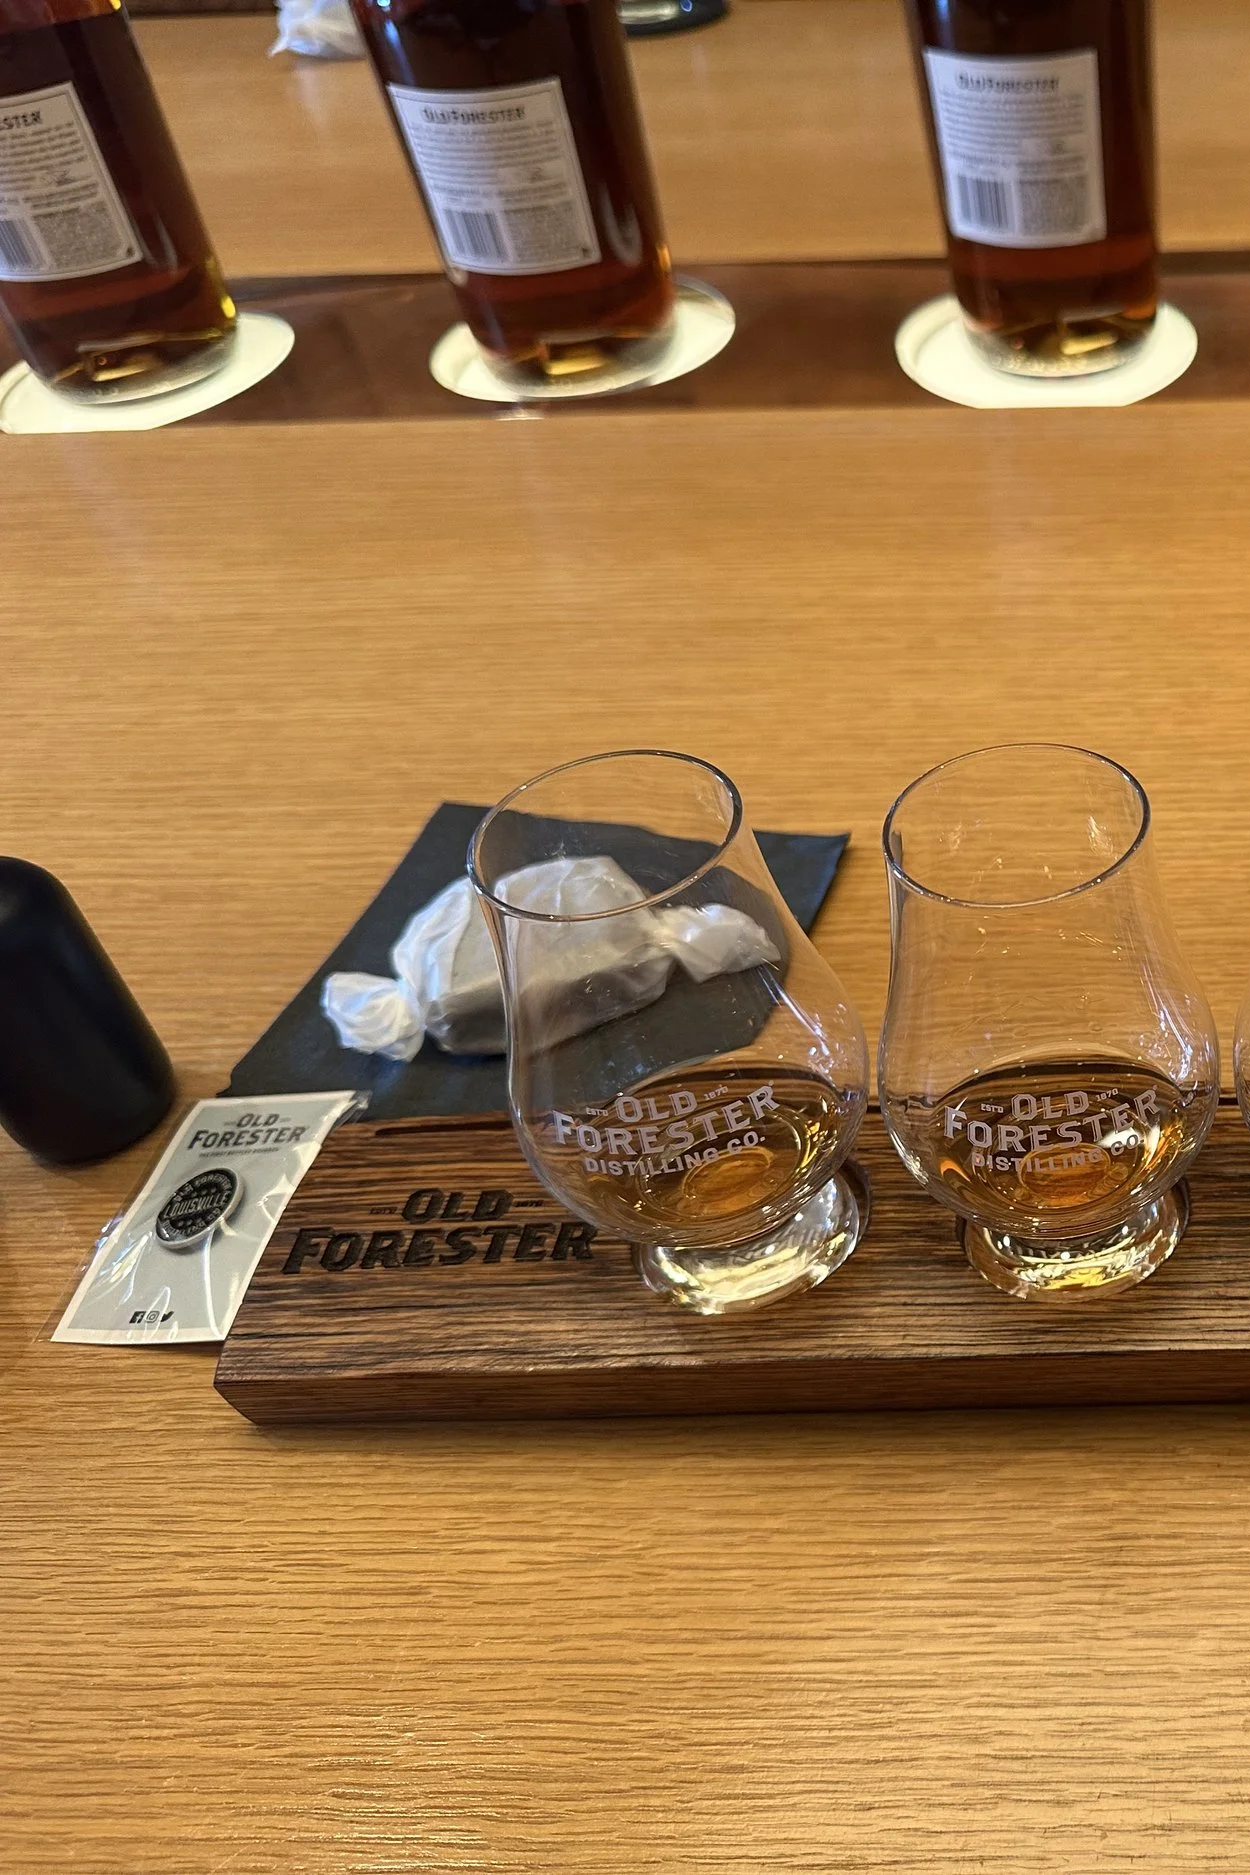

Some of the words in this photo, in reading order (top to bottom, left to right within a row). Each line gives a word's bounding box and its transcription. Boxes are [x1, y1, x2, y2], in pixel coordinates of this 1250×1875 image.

[0, 111, 43, 131] STER
[615, 1090, 698, 1123] OLD
[703, 1085, 729, 1101] 1870
[1011, 1090, 1090, 1121] OLD
[1095, 1088, 1119, 1101] 1870
[236, 1112, 280, 1128] OLD
[552, 1085, 780, 1156] FORESTER
[943, 1089, 1161, 1152] FORESTER
[187, 1126, 309, 1150] FORESTER
[584, 1147, 719, 1177] DISTILLING
[971, 1153, 1104, 1173] DISTILLING
[163, 1190, 231, 1219] LOUISVILLE
[401, 1187, 514, 1224] OLD
[281, 1221, 598, 1275] FORESTER
